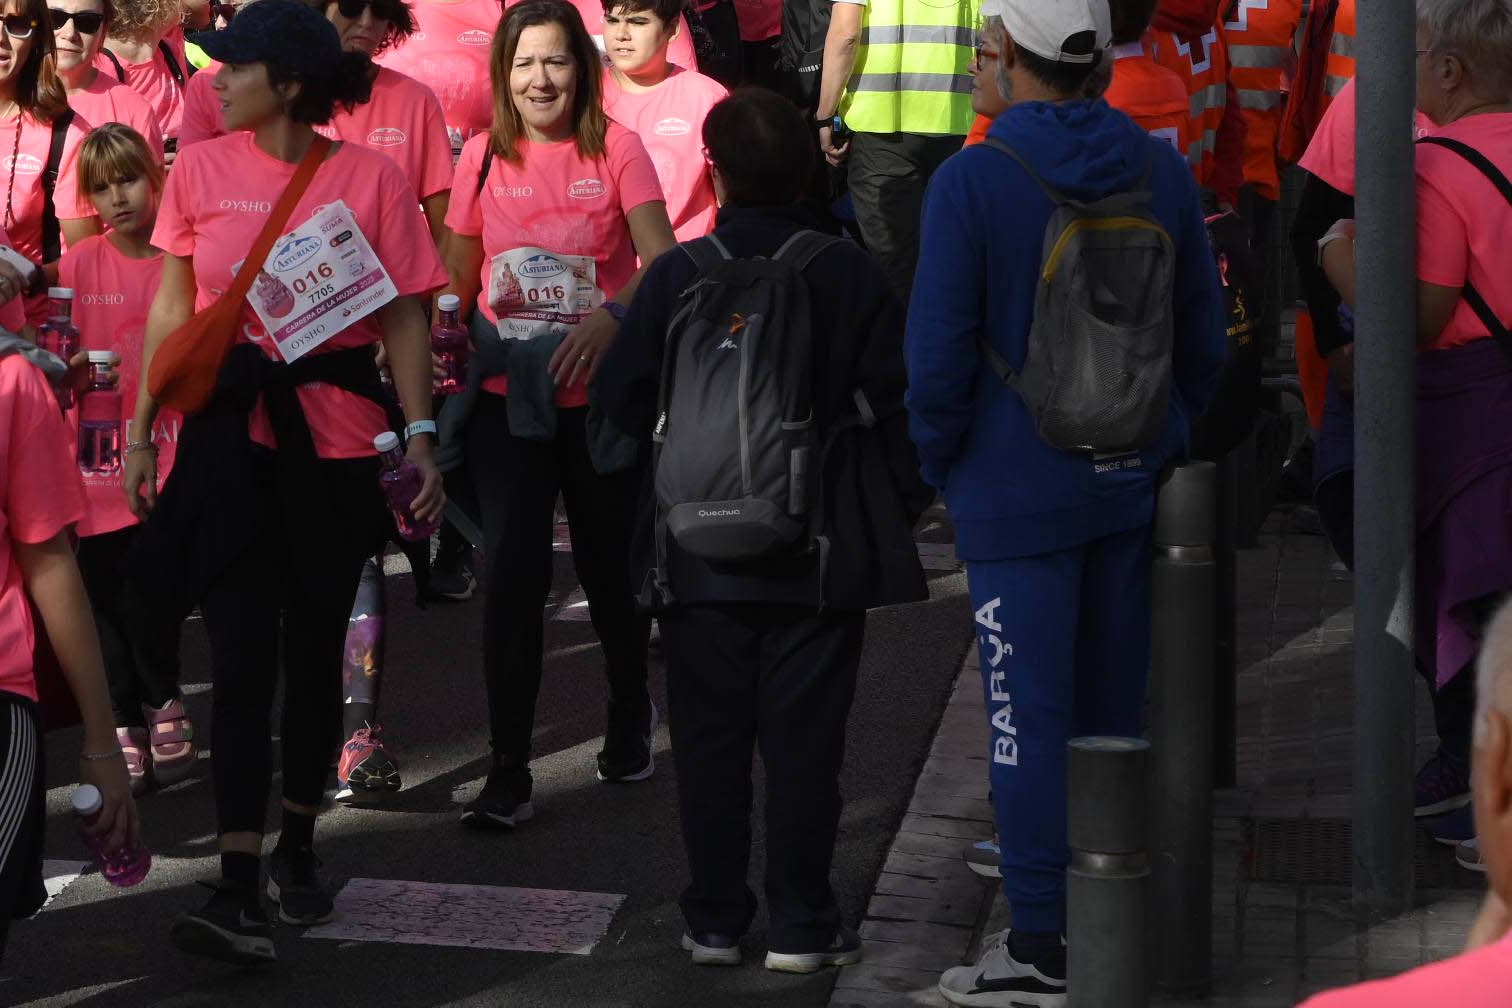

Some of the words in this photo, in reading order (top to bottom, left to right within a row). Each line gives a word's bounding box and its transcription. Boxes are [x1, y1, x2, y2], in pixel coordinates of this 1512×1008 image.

[493, 185, 533, 198] OYSHO
[220, 199, 272, 213] OYSHO
[277, 240, 320, 270] ASTURIANA
[292, 262, 333, 293] 016
[522, 264, 564, 275] ASTURIANA
[81, 293, 124, 305] OYSHO
[308, 283, 334, 304] 7705
[350, 287, 385, 312] Santander
[528, 285, 565, 302] 016
[285, 312, 316, 334] CARRERA
[317, 304, 326, 313] DE
[327, 298, 336, 308] LA
[336, 286, 358, 303] MUJER
[291, 323, 326, 350] OYSHO
[1095, 461, 1121, 473] SINCE
[698, 509, 741, 517] Quechua
[975, 596, 1018, 767] BARÇA
